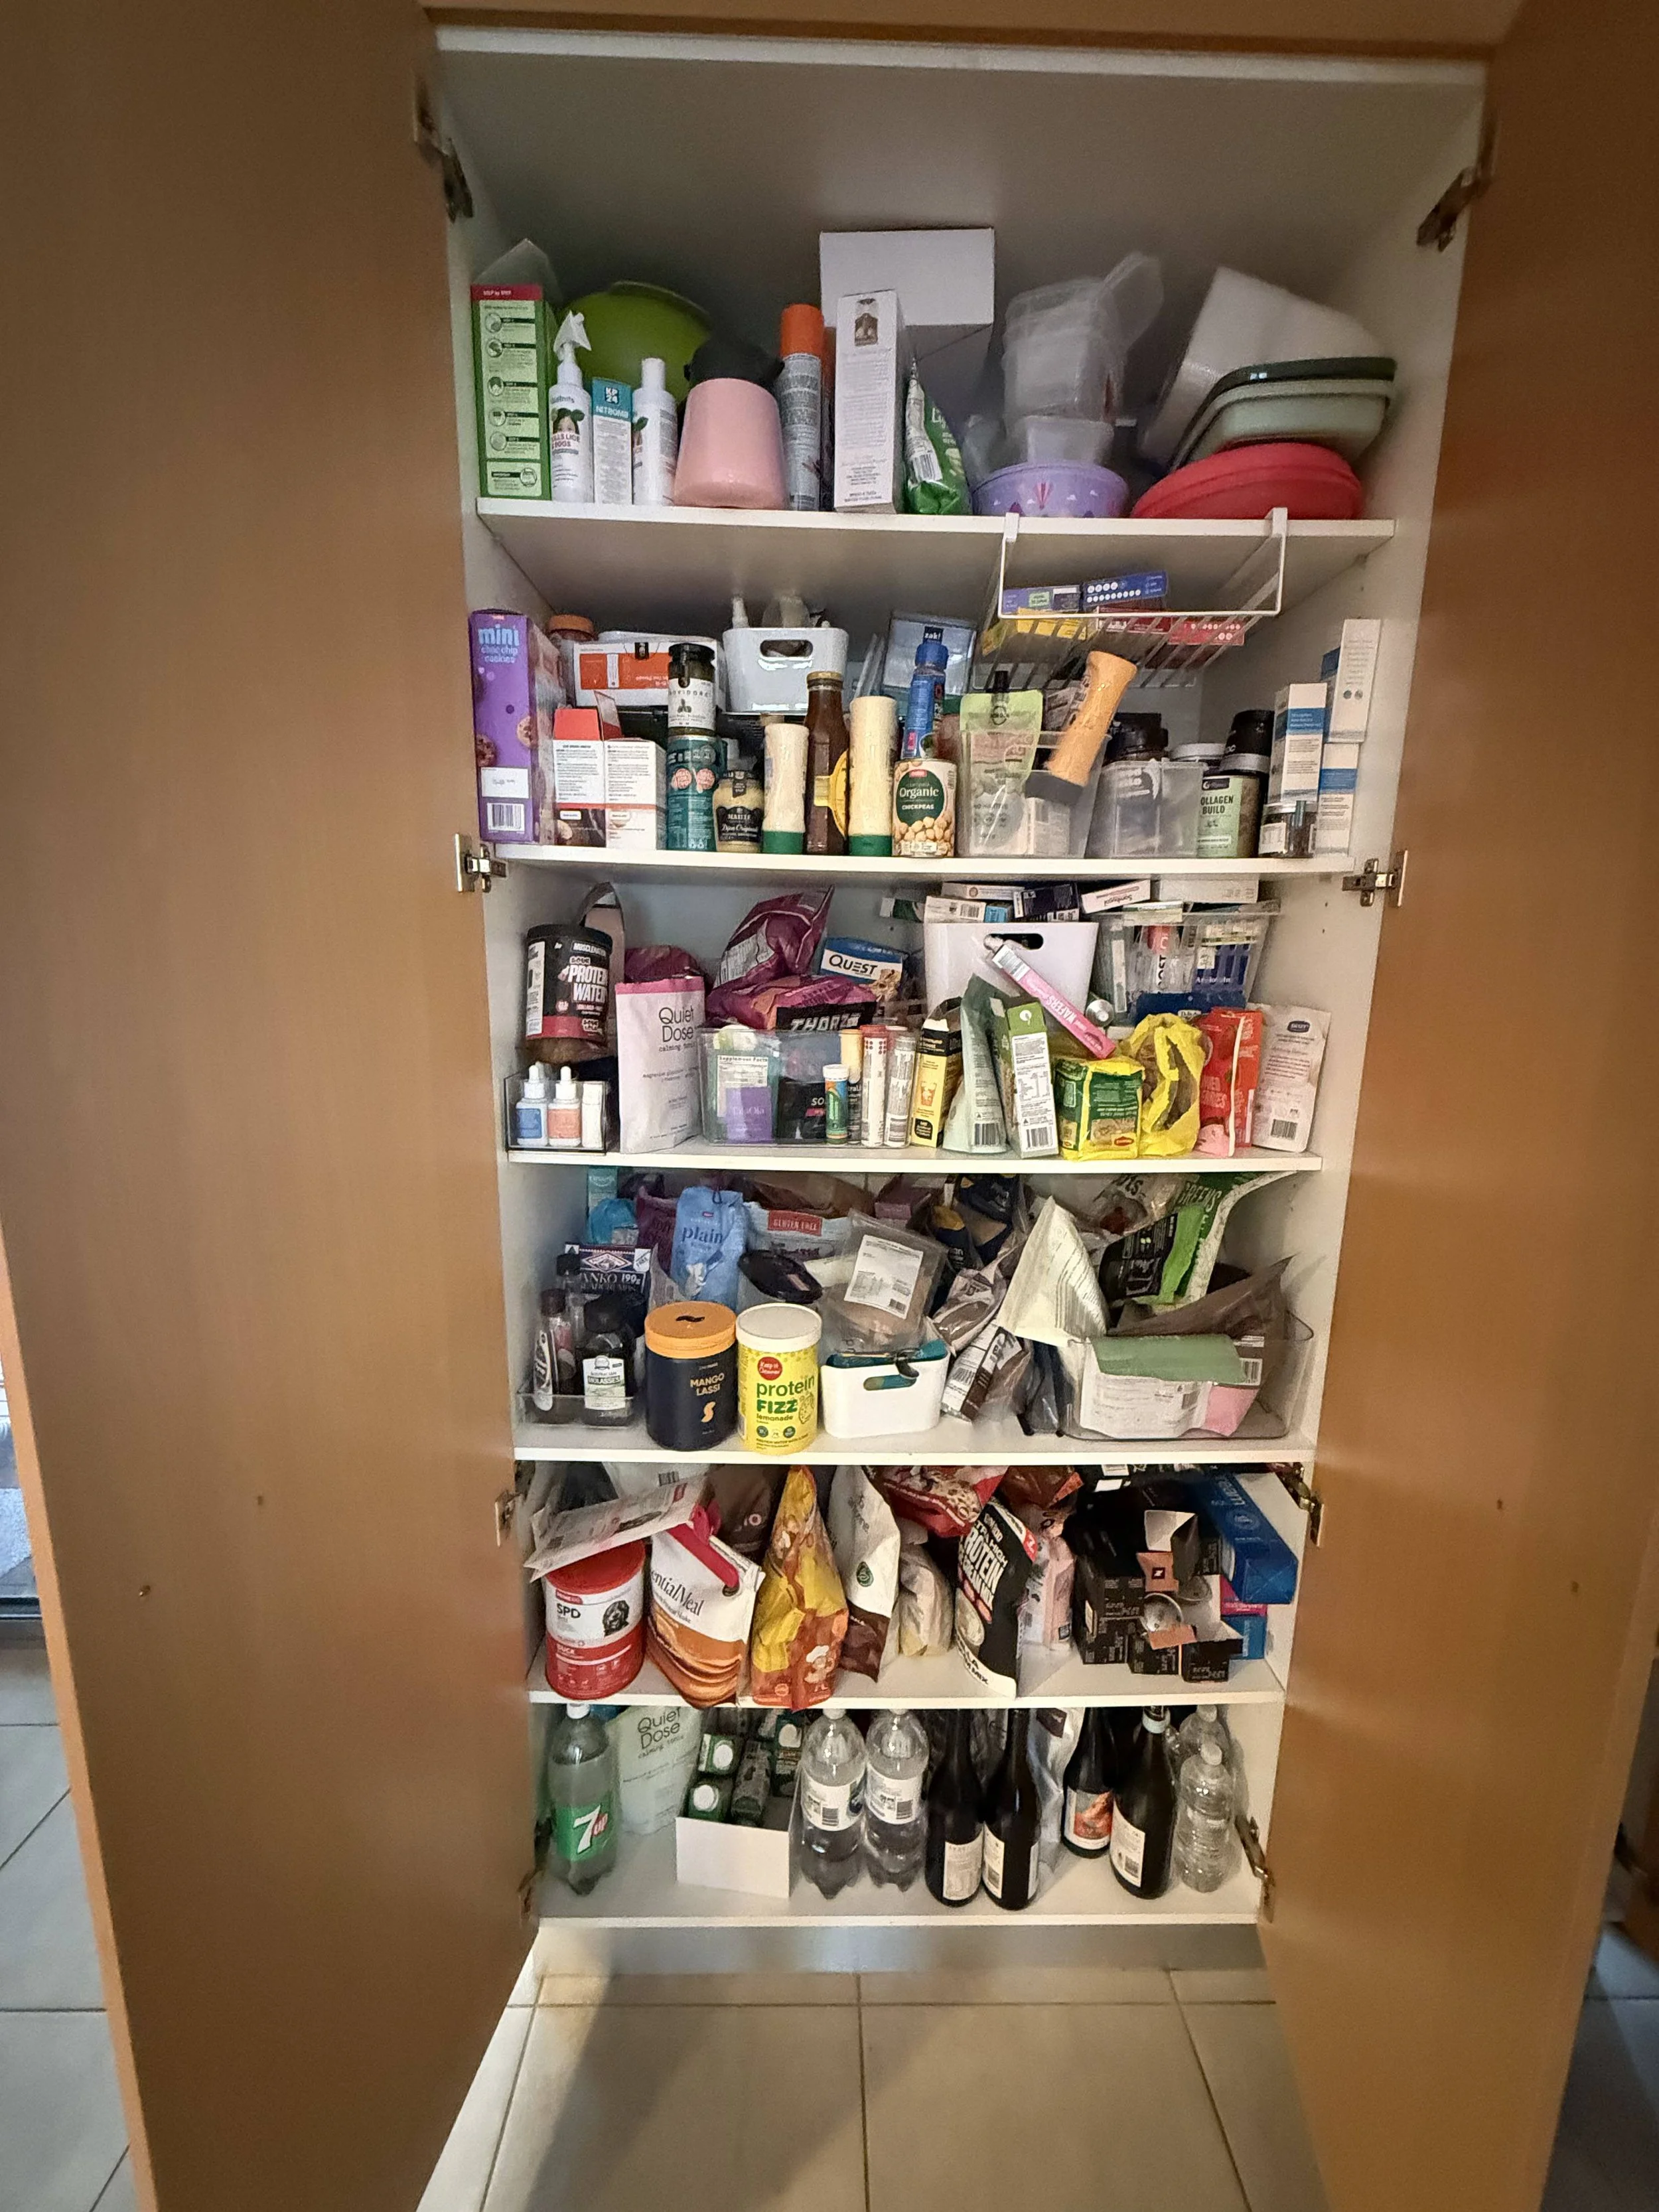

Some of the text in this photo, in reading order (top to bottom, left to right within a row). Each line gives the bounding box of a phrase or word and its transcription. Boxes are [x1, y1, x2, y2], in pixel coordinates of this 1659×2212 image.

[605, 387, 618, 396] KP
[605, 395, 618, 404] 24
[478, 624, 520, 646] mini
[501, 646, 518, 657] chip
[899, 786, 940, 799] Organic
[1202, 805, 1225, 815] BUILD
[830, 954, 878, 975] QUEST
[658, 1005, 694, 1025] Quiet
[1045, 994, 1078, 1025] WAFERS
[662, 1025, 694, 1043] Dose
[682, 1226, 723, 1244] plain
[690, 1372, 725, 1388] MANGO
[757, 1375, 815, 1398] protein
[696, 1384, 721, 1396] LASSI
[757, 1399, 798, 1414] FIZZ
[989, 1539, 1009, 1568] HIGH
[556, 1603, 581, 1619] SPD
[638, 1706, 680, 1733] Quiet
[641, 1722, 680, 1749] Dose
